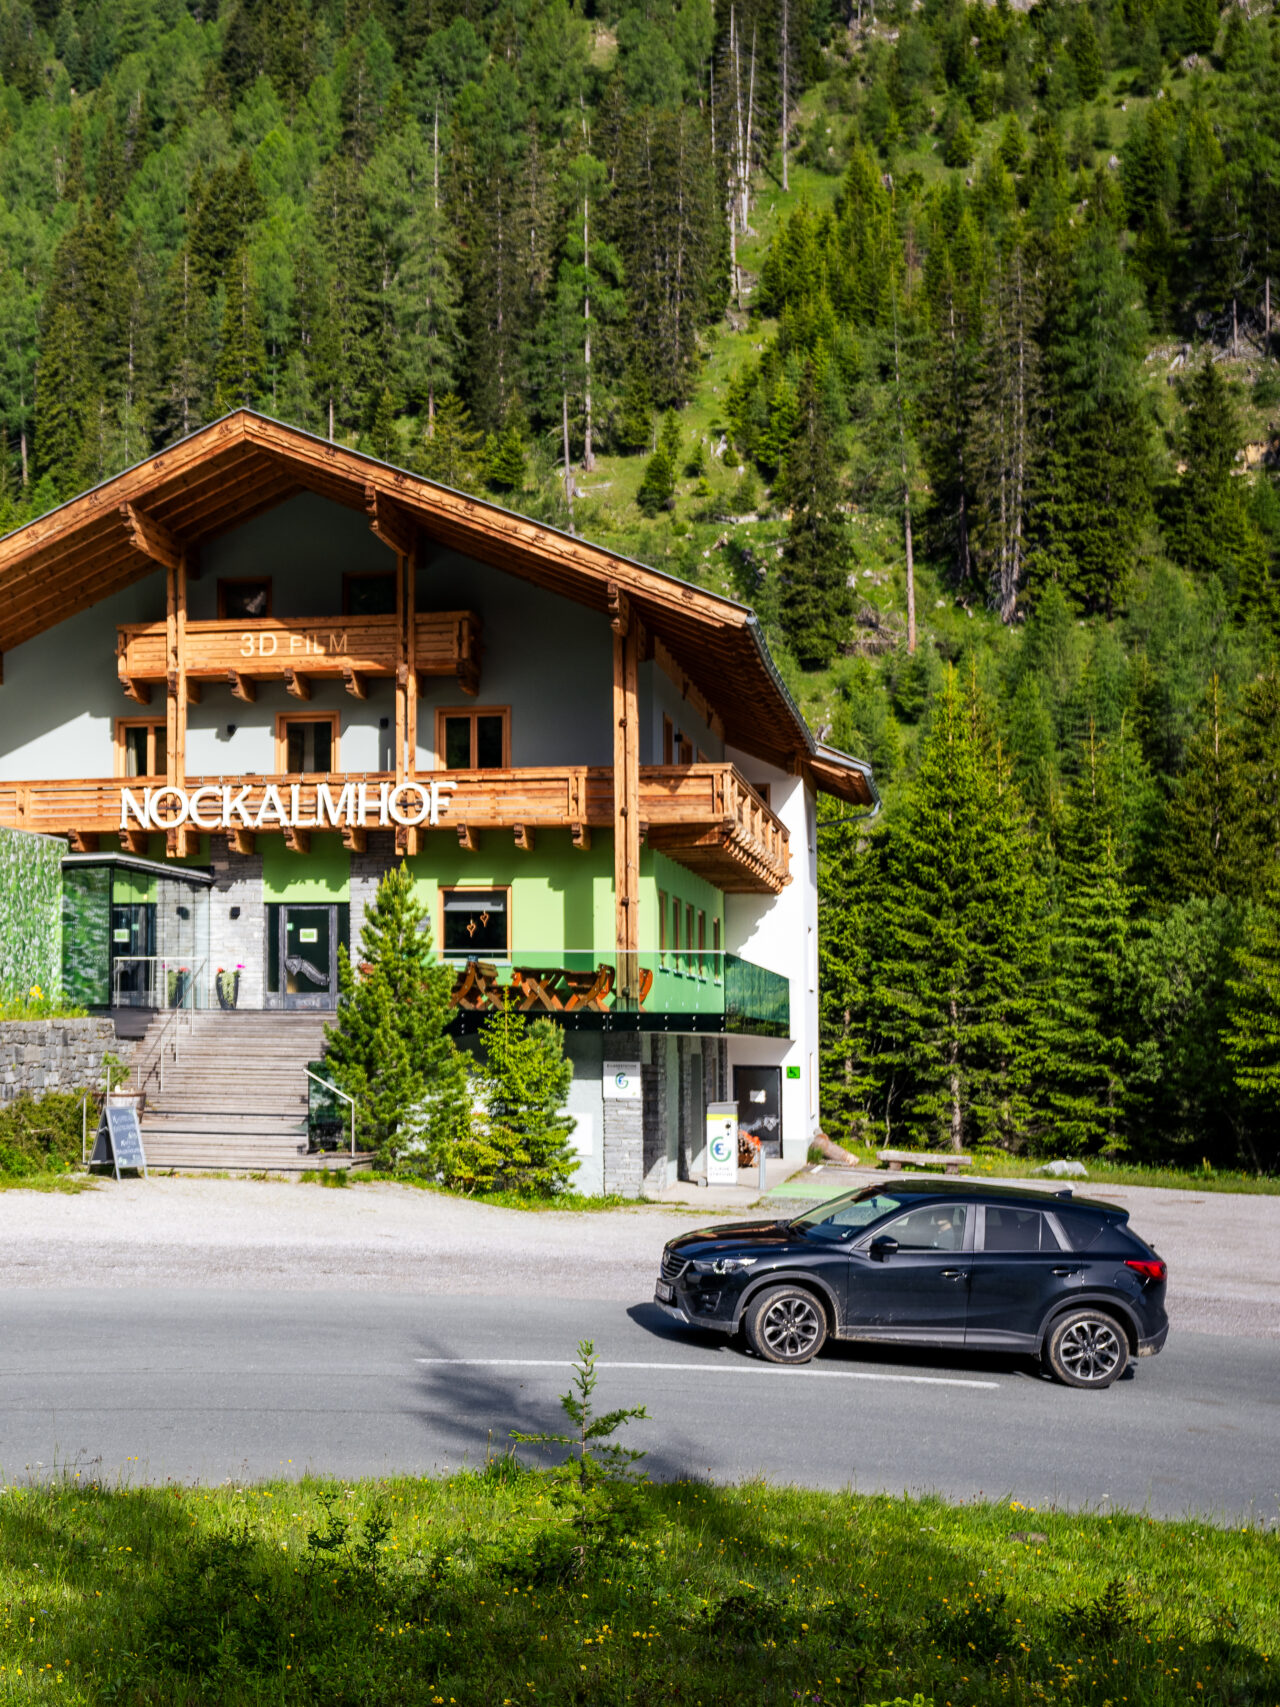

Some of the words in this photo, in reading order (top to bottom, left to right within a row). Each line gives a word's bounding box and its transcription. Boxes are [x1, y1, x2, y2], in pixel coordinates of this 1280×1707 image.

[239, 633, 278, 657] 3D
[289, 633, 348, 655] FILM
[120, 781, 458, 829] NOCKALMHOF
